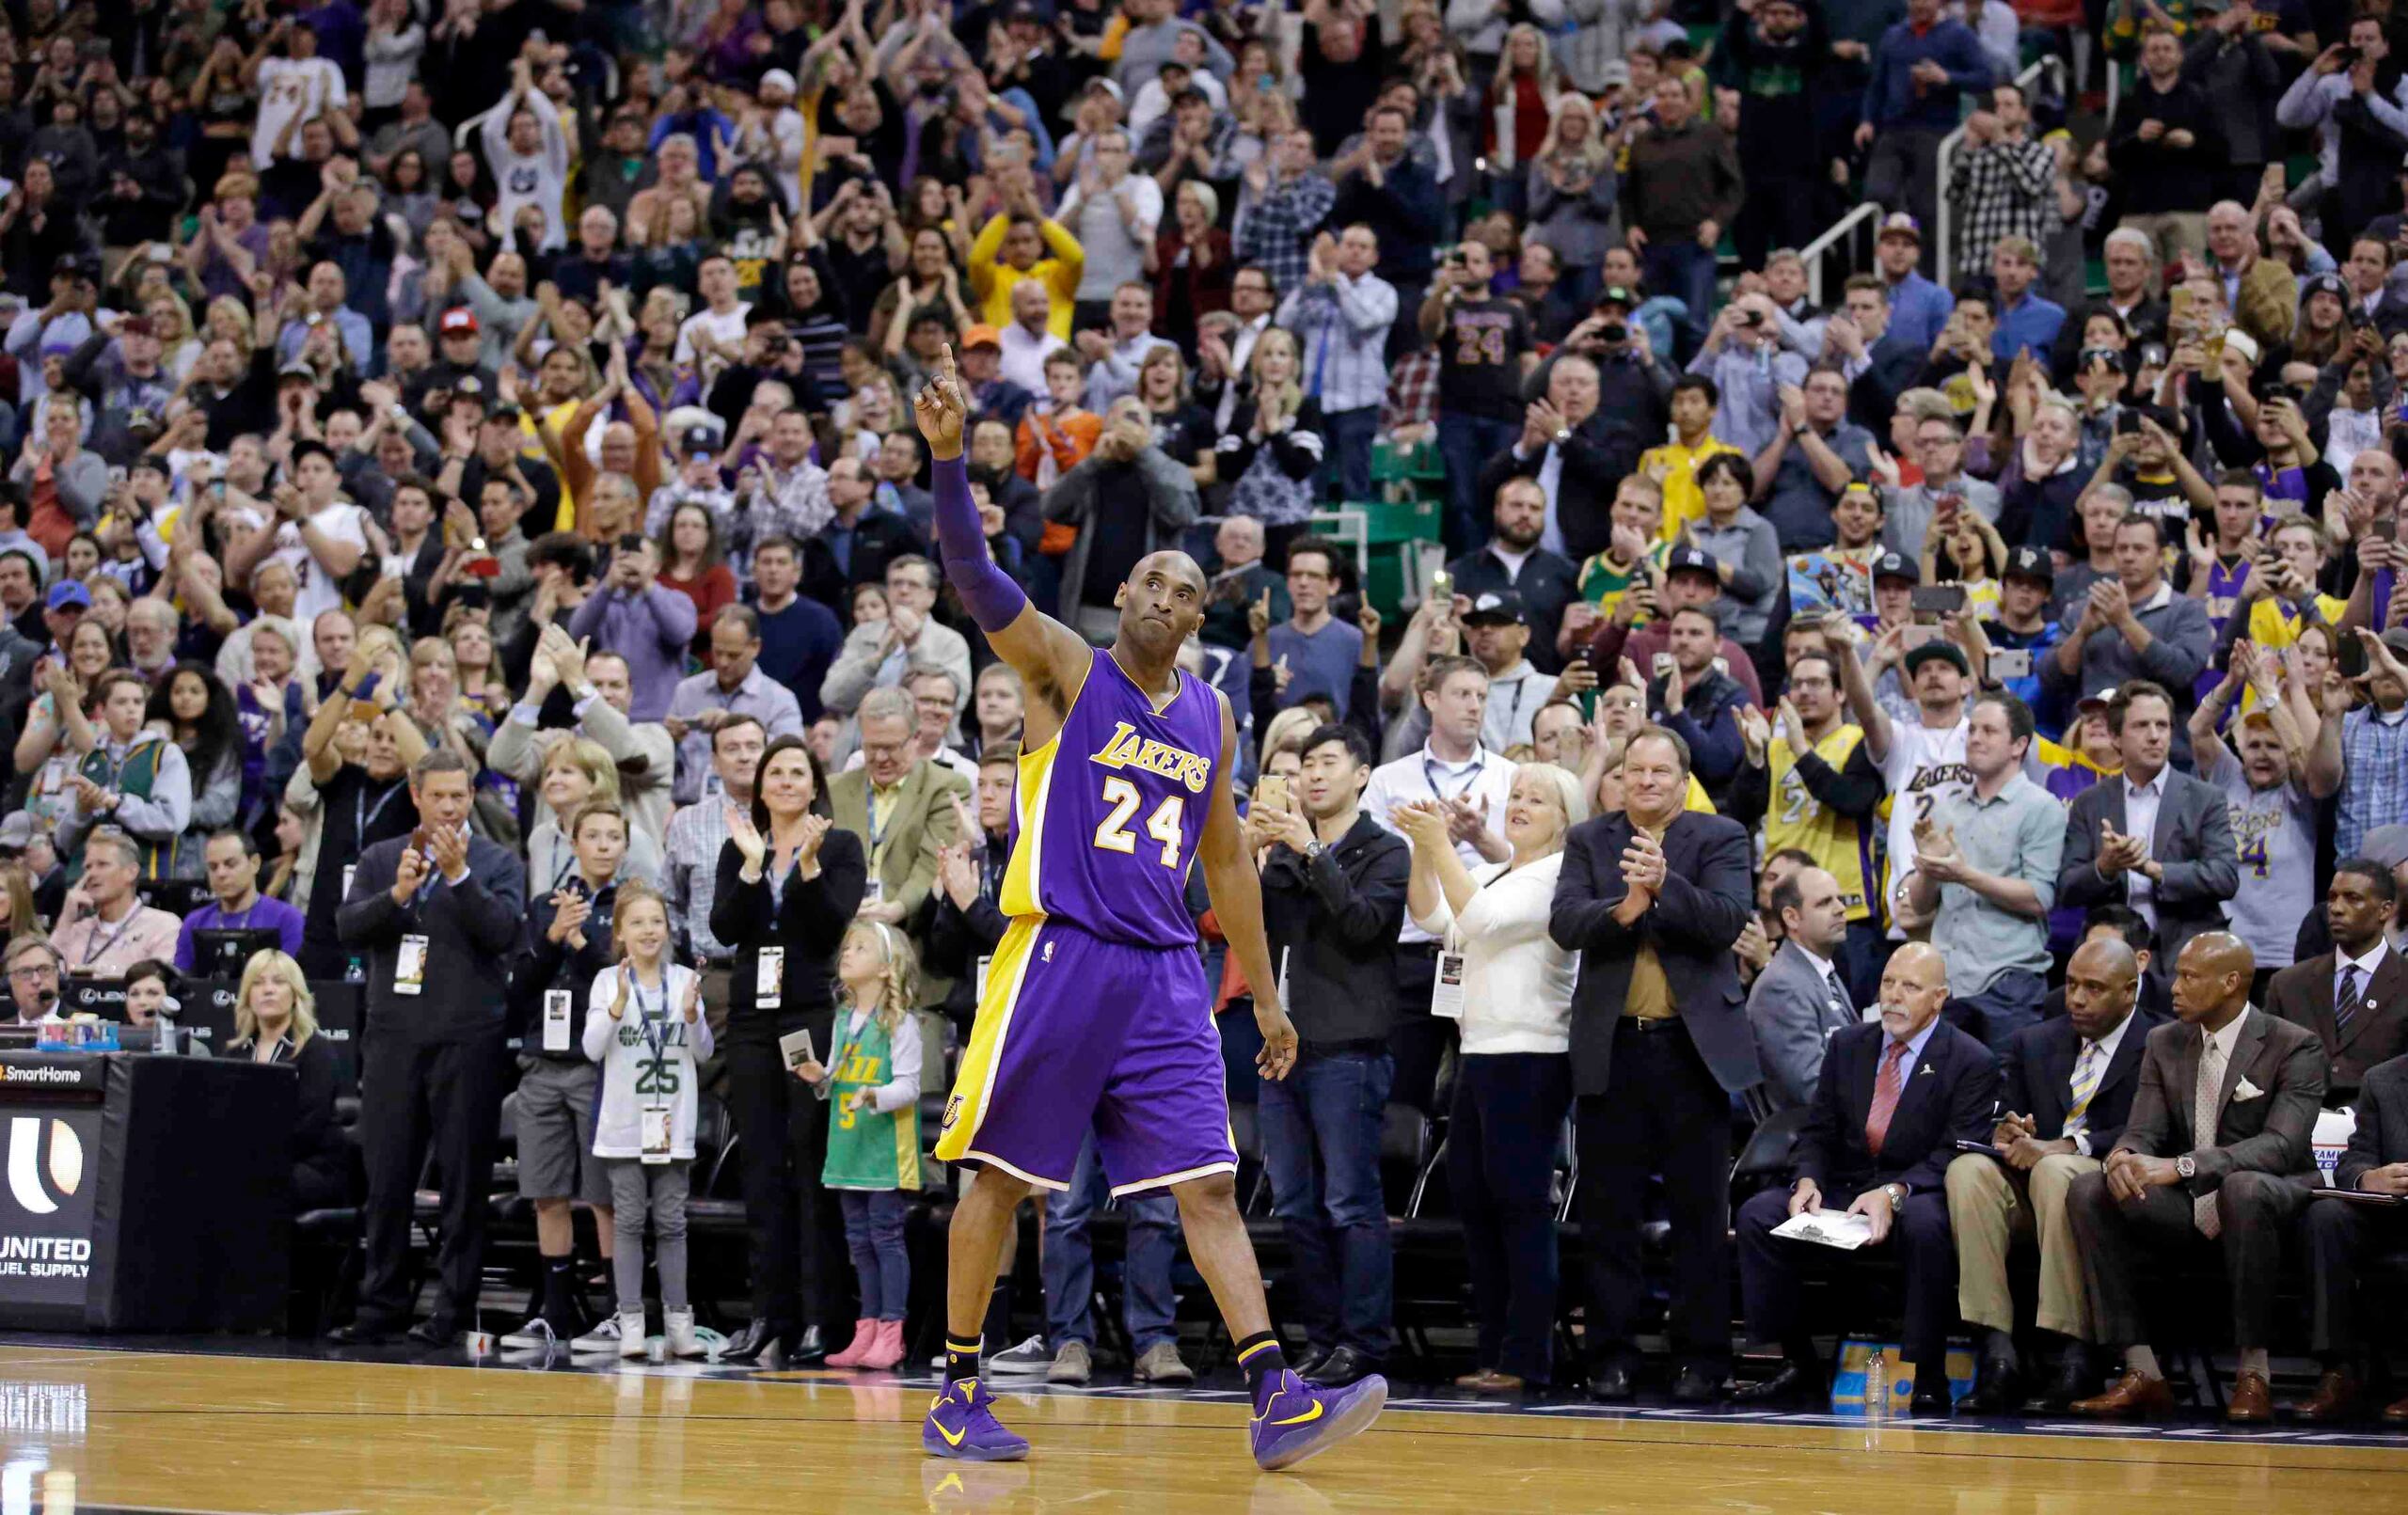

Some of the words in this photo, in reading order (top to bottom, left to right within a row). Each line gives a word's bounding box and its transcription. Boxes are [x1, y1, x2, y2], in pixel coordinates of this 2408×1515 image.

[1456, 325, 1505, 365] 24
[1088, 720, 1212, 794] LAKERS
[1093, 775, 1184, 870] 24
[97, 991, 127, 1002] LEX
[635, 1058, 680, 1095] 25
[0, 1262, 26, 1275] UEL
[30, 1263, 89, 1278] SUPPLY
[2024, 1423, 2408, 1441] SUP
